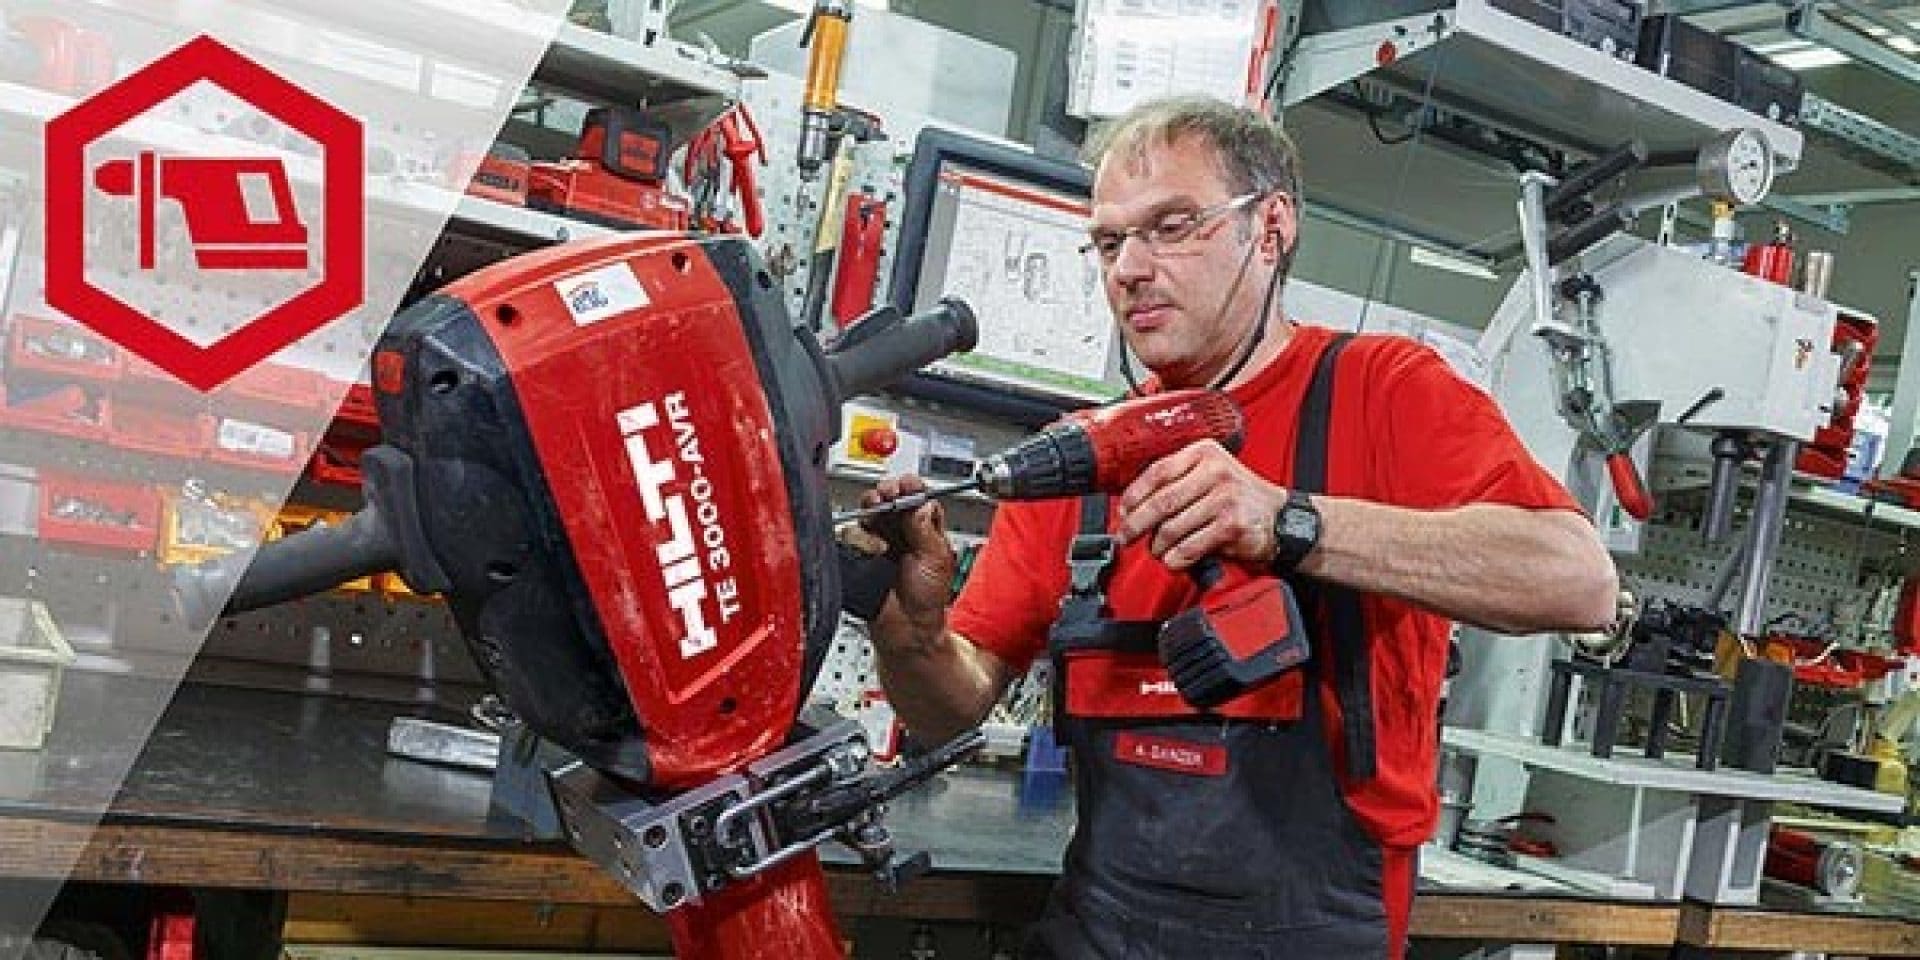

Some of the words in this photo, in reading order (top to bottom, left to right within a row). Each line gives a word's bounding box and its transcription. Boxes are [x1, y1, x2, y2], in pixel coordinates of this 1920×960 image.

[616, 402, 717, 659] HILTI
[664, 390, 731, 571] 3000-AVR
[716, 576, 743, 624] TE
